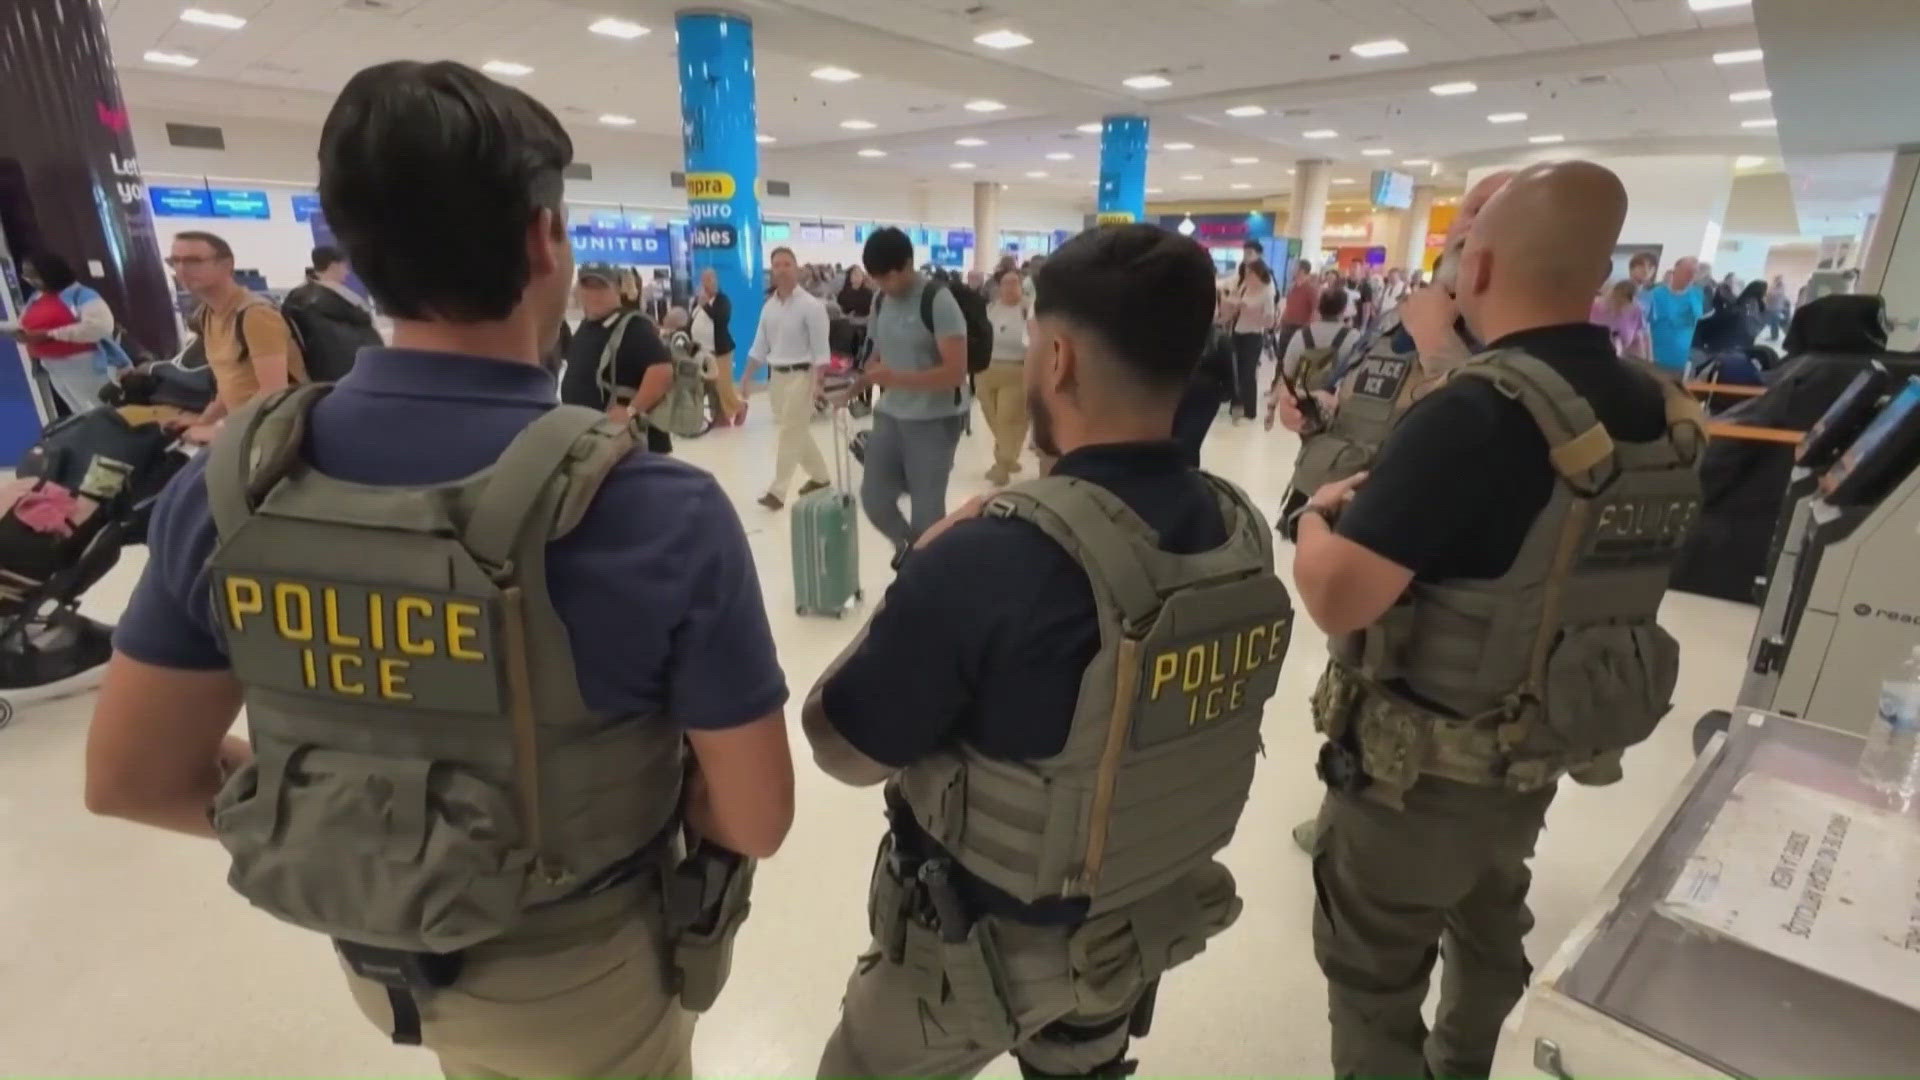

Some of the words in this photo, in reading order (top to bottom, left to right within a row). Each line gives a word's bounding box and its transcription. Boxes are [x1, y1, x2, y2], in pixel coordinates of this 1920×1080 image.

[689, 204, 732, 221] guro
[573, 236, 659, 252] UNITED
[1361, 358, 1405, 379] POLICE
[225, 576, 485, 661] POLICE
[304, 648, 414, 700] ICE
[1151, 618, 1286, 701] POLICE
[1189, 678, 1247, 726] ICE
